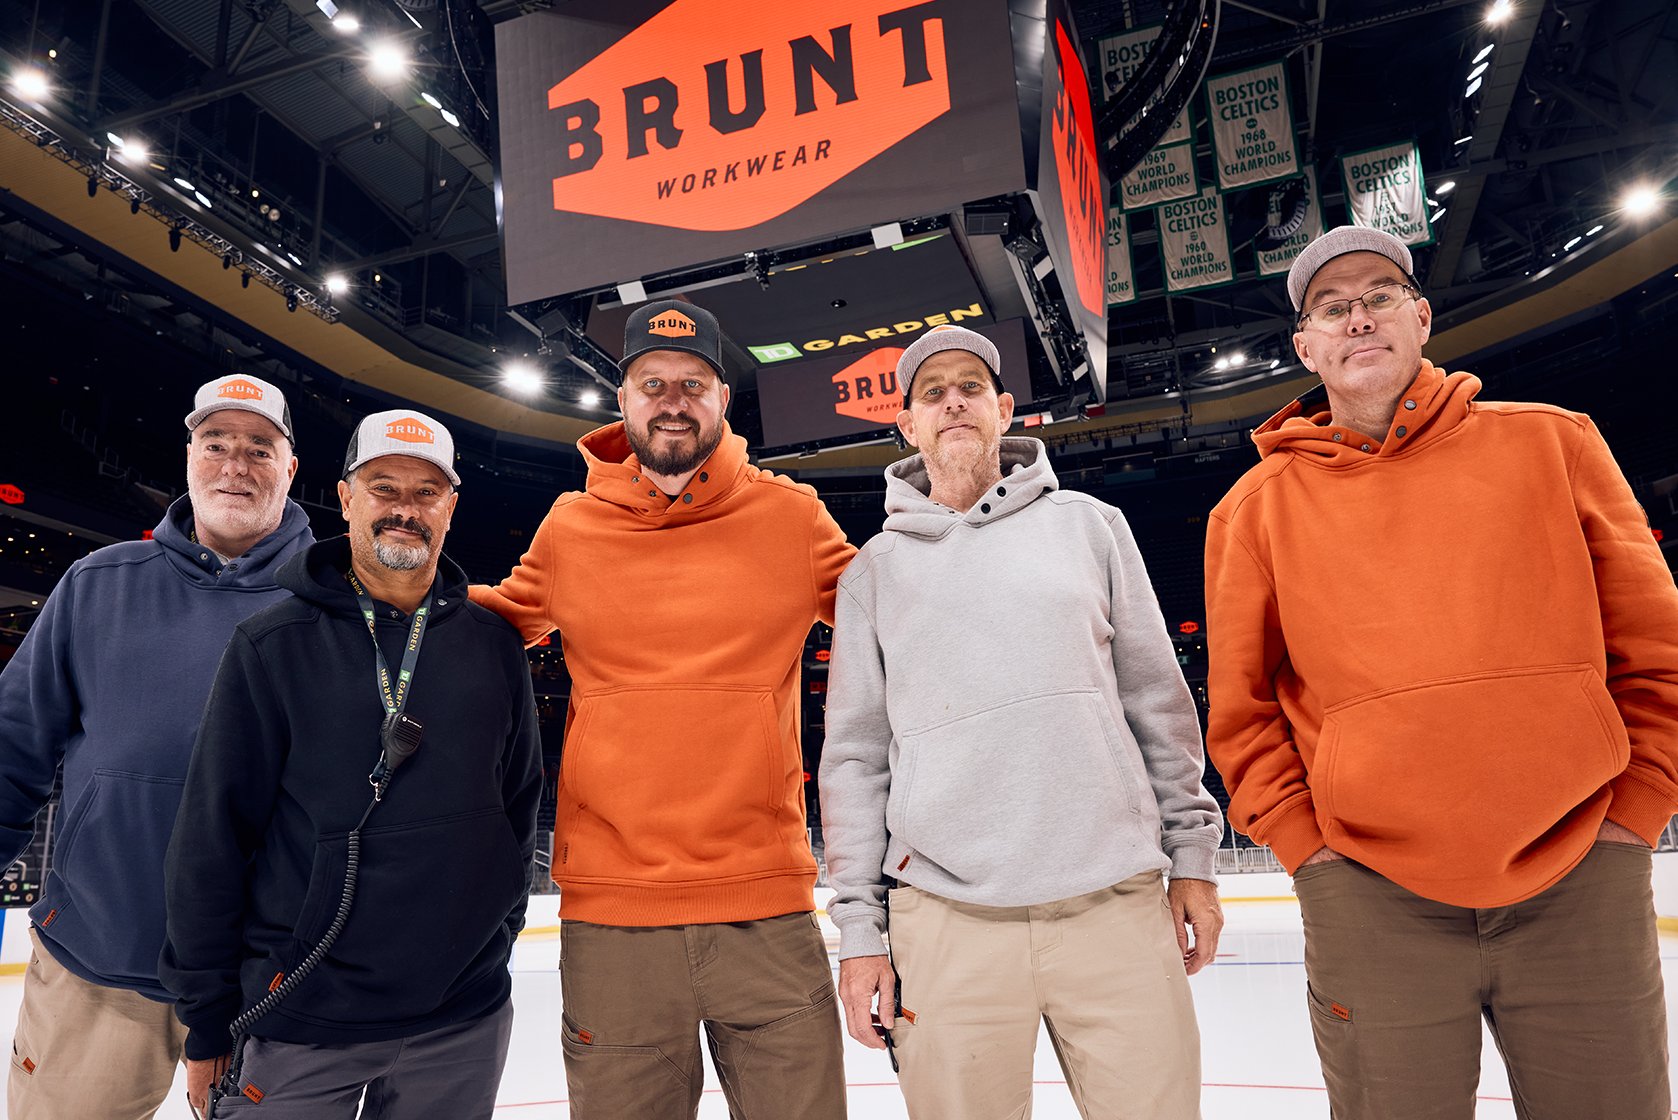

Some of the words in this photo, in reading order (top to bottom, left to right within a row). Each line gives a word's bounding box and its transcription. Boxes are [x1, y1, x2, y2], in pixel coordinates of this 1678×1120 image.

[1107, 39, 1156, 66] BOST
[549, 0, 943, 180] BRUNT
[1215, 76, 1279, 105] BOSTON
[1220, 94, 1279, 121] CELTICS
[1240, 129, 1266, 145] 1968
[1143, 151, 1166, 166] 1969
[1235, 141, 1276, 159] WORLD
[657, 139, 833, 200] WORKWEAR
[1053, 60, 1105, 286] BRUNT
[1137, 163, 1176, 181] WORLD
[1224, 151, 1292, 176] CHAMPIONS
[1351, 154, 1409, 179] BOSTON
[1127, 173, 1190, 196] CHAMPIONS
[1355, 170, 1410, 194] CELTICS
[1164, 196, 1218, 219] BOSTON
[1374, 202, 1396, 215] 1957
[1168, 211, 1218, 233] CELTICS
[1371, 213, 1409, 228] WORLD
[1185, 241, 1206, 254] 1960
[1279, 233, 1309, 248] ORLD
[1171, 261, 1227, 280] CHAMPIONS
[1180, 252, 1214, 267] WORLD
[649, 319, 697, 332] BRUNT
[754, 346, 794, 360] TD
[802, 302, 984, 352] GARDEN
[217, 385, 263, 398] BRUNT
[833, 371, 897, 403] BRU
[866, 401, 903, 413] WORKWE
[386, 425, 435, 441] BRUNT
[408, 615, 424, 652] GARDEN
[380, 668, 394, 707] GARDEN
